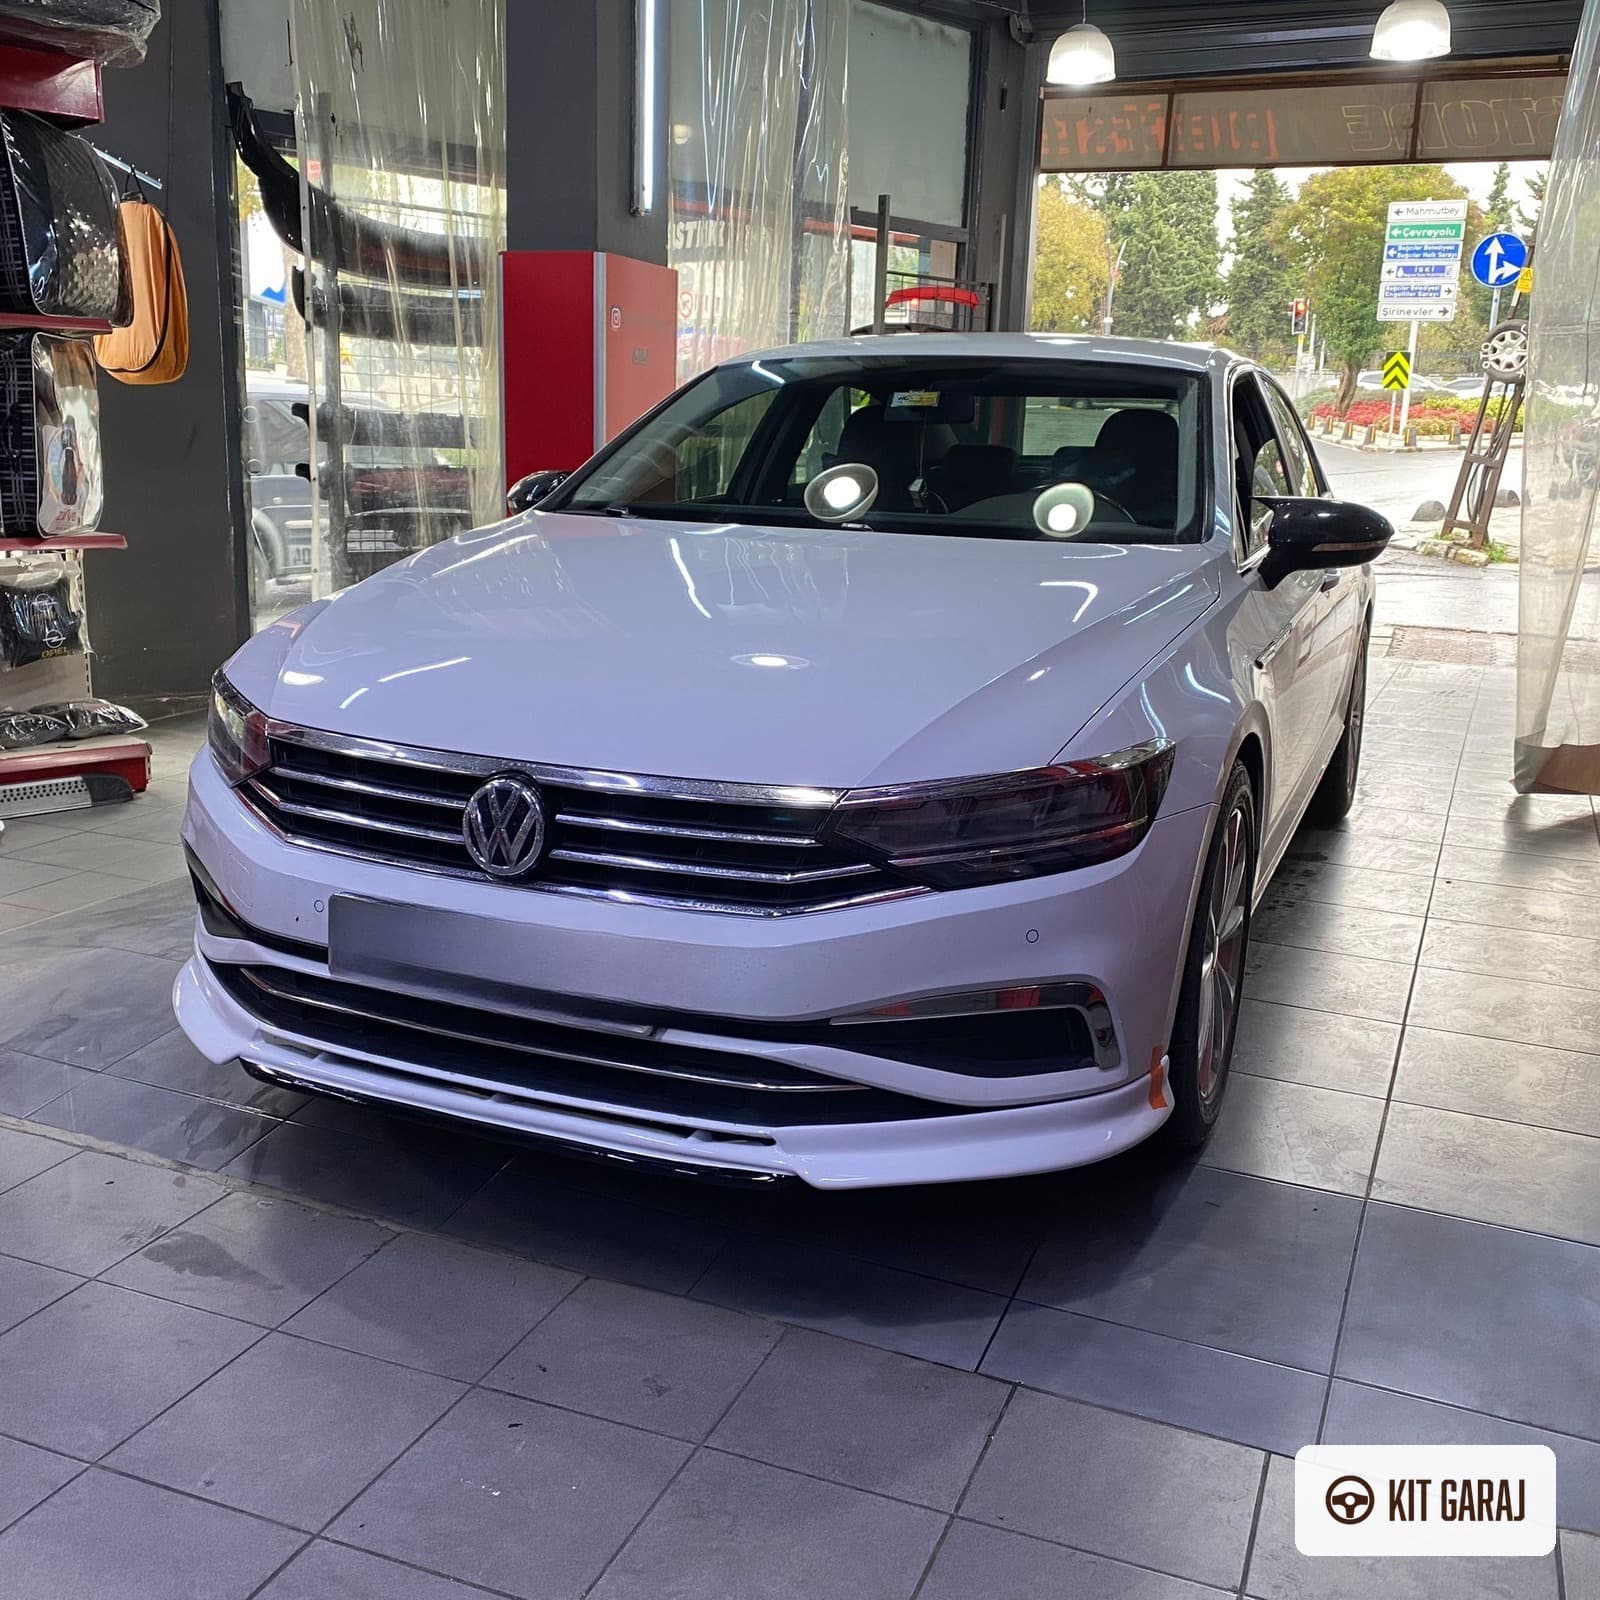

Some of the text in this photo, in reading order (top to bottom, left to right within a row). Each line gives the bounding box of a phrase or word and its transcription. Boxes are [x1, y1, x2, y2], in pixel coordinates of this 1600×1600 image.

[1405, 207, 1460, 217] Mahmutbey
[1402, 227, 1456, 238] Çevreyolu
[1382, 307, 1433, 316] Şirinevler
